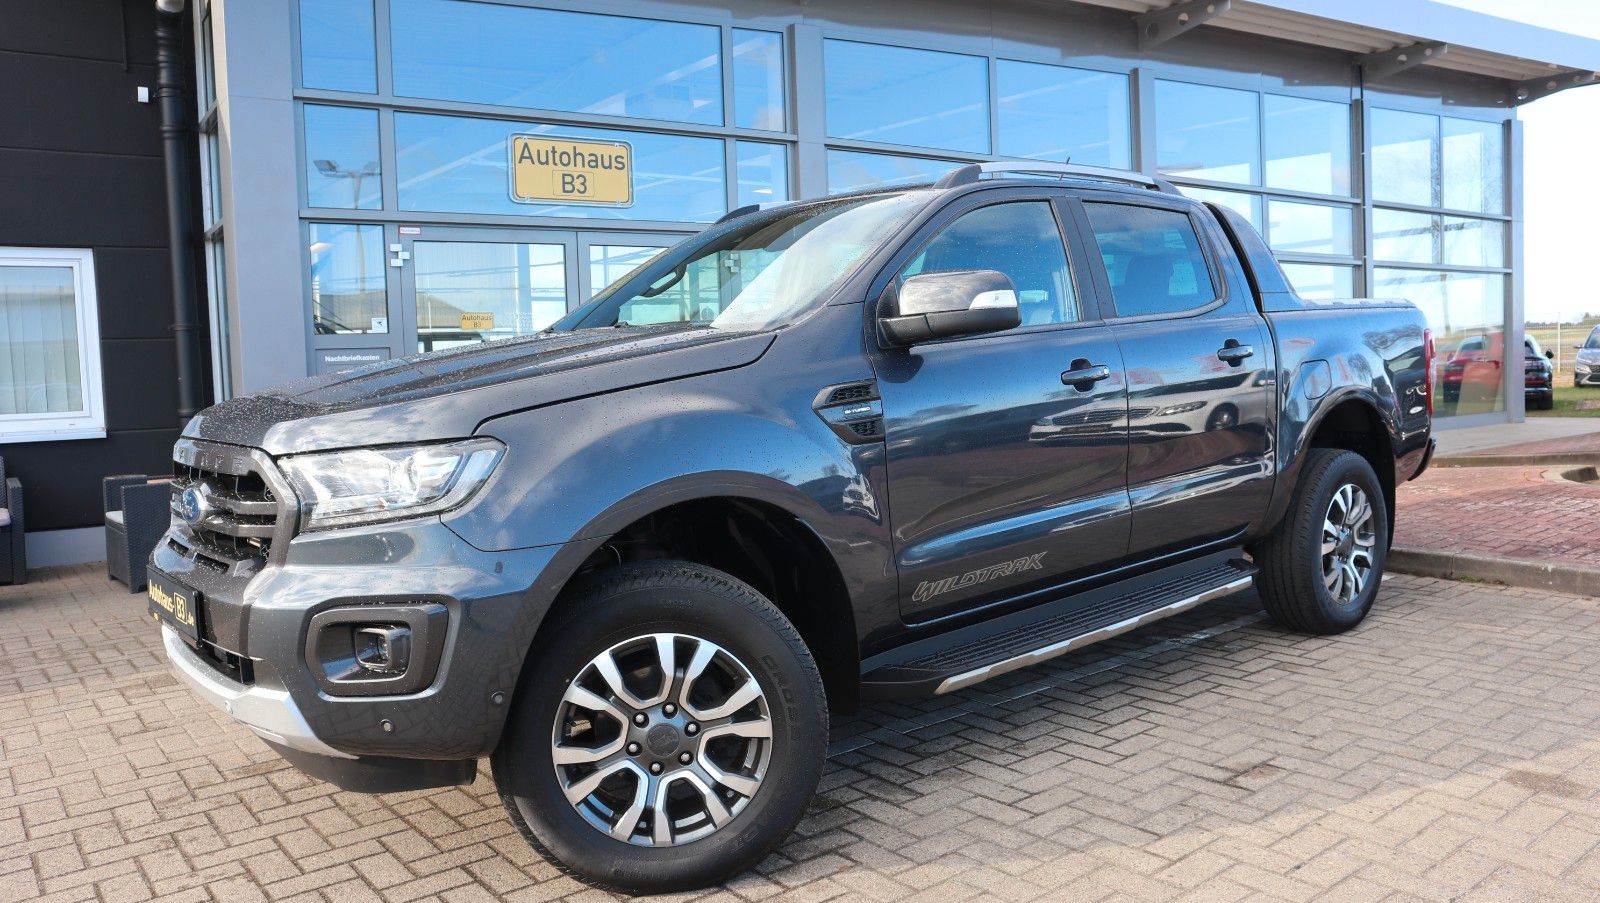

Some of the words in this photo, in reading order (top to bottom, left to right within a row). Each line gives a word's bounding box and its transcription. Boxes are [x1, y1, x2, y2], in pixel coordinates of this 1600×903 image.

[518, 142, 626, 171] Autohaus
[561, 173, 588, 195] B3
[462, 313, 493, 321] Autohaus
[911, 550, 1049, 602] WILDTRAK
